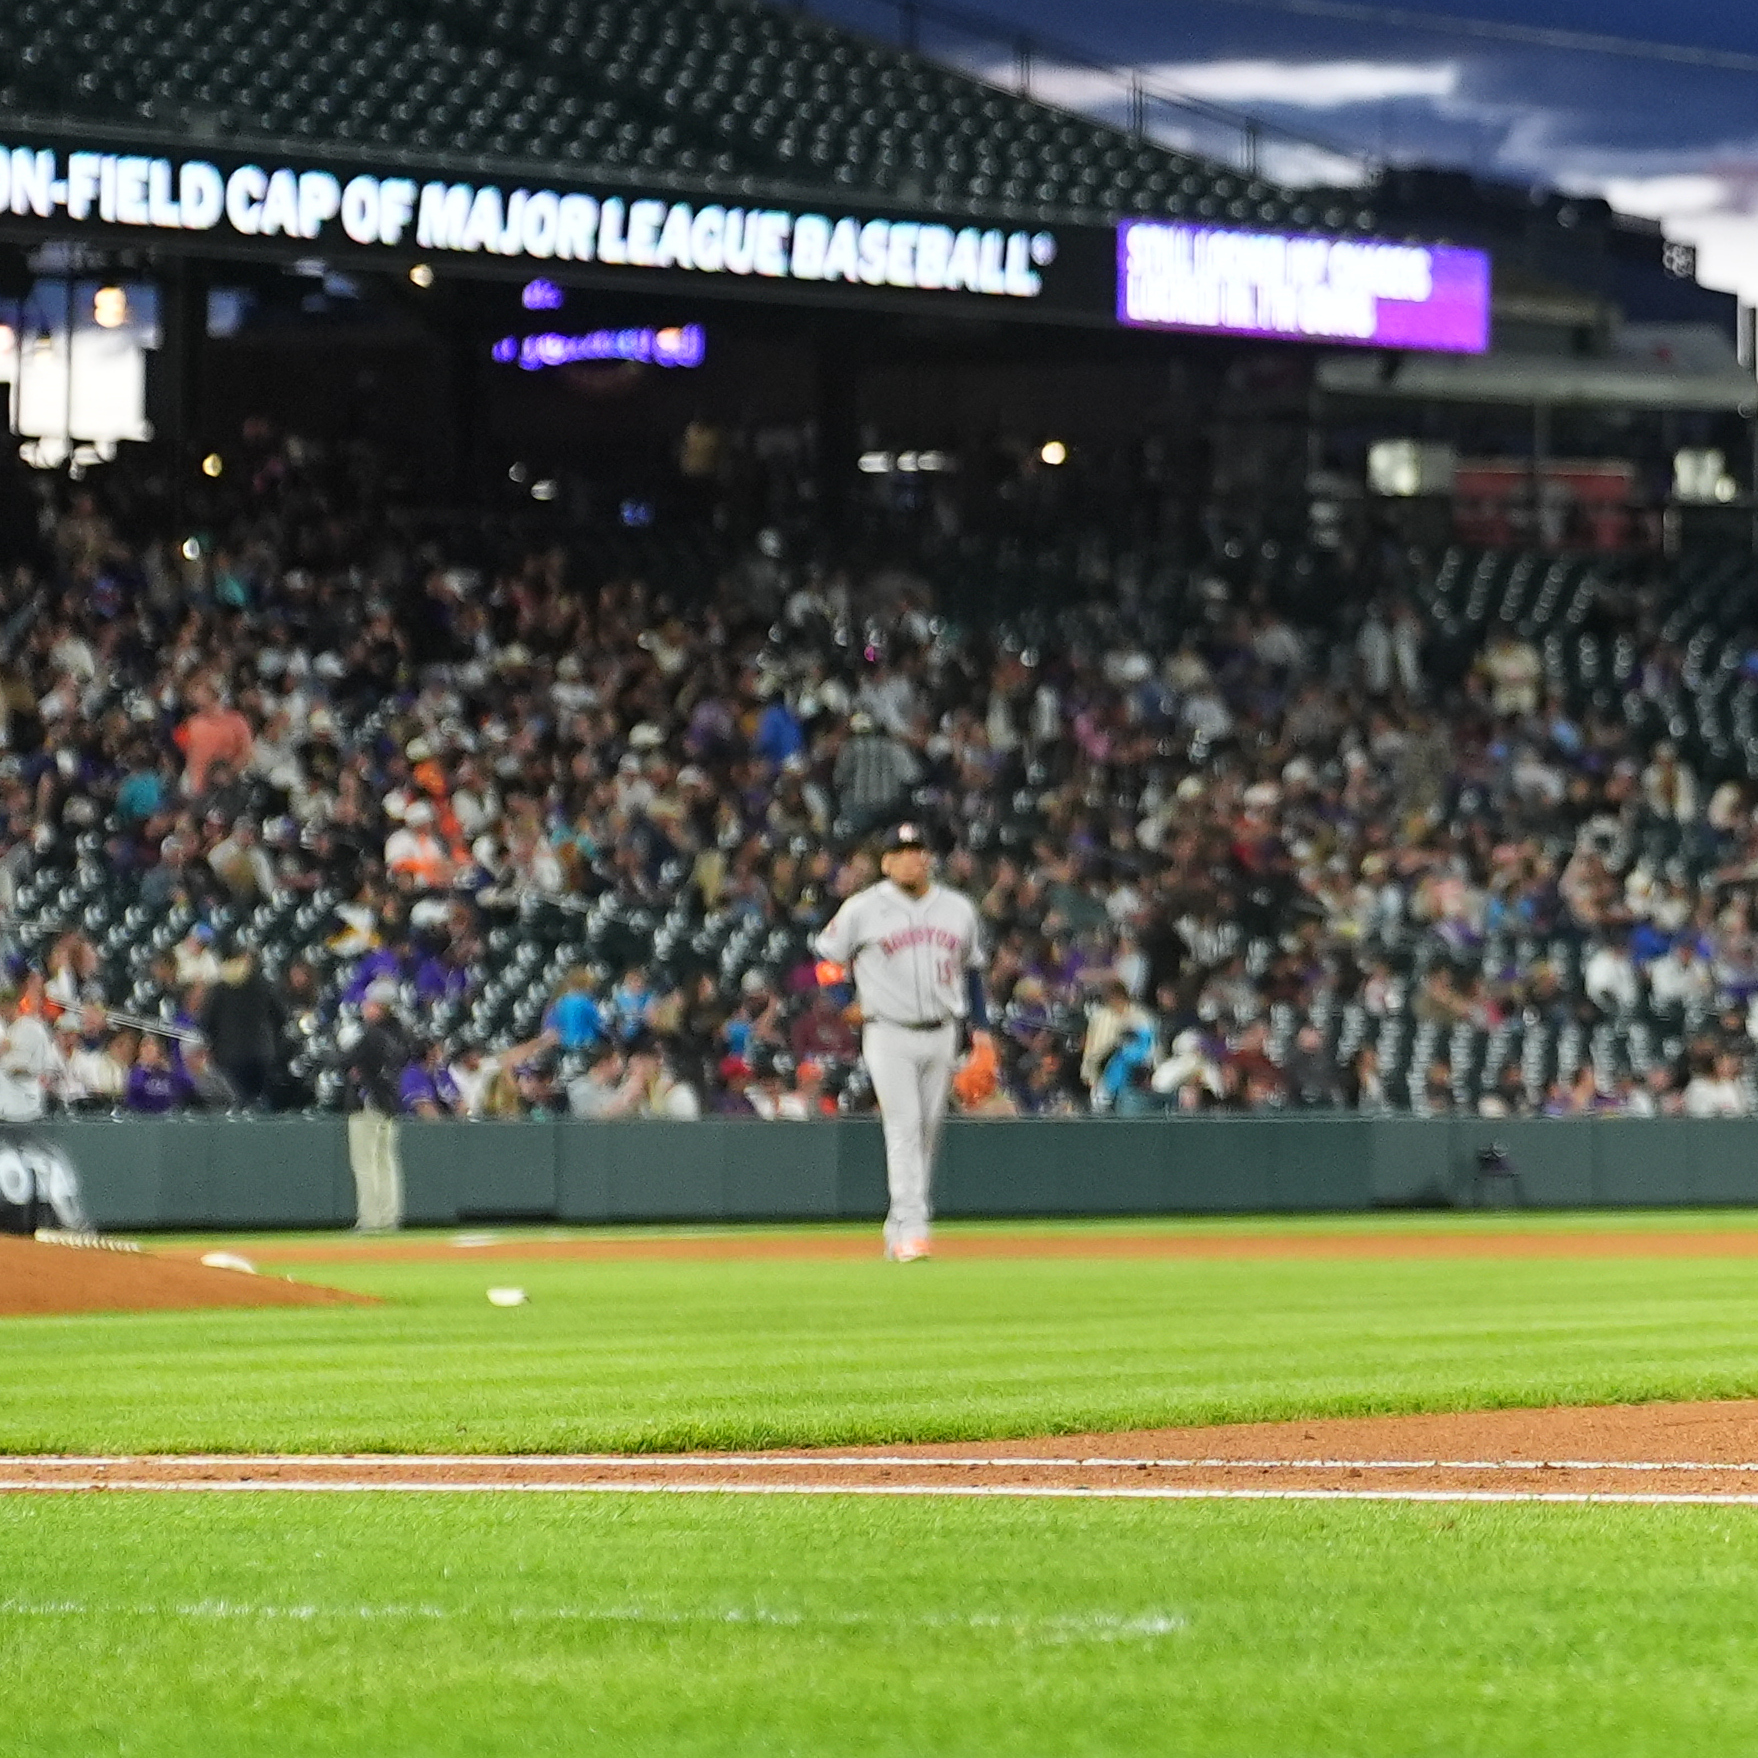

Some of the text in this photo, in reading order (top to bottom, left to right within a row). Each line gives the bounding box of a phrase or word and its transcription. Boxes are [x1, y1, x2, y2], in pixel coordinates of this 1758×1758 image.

[0, 147, 224, 230] N-FIELD
[226, 164, 342, 239] CAP
[341, 173, 417, 246] OF
[416, 179, 599, 262] MAJOR
[598, 195, 789, 277] LEAGUE
